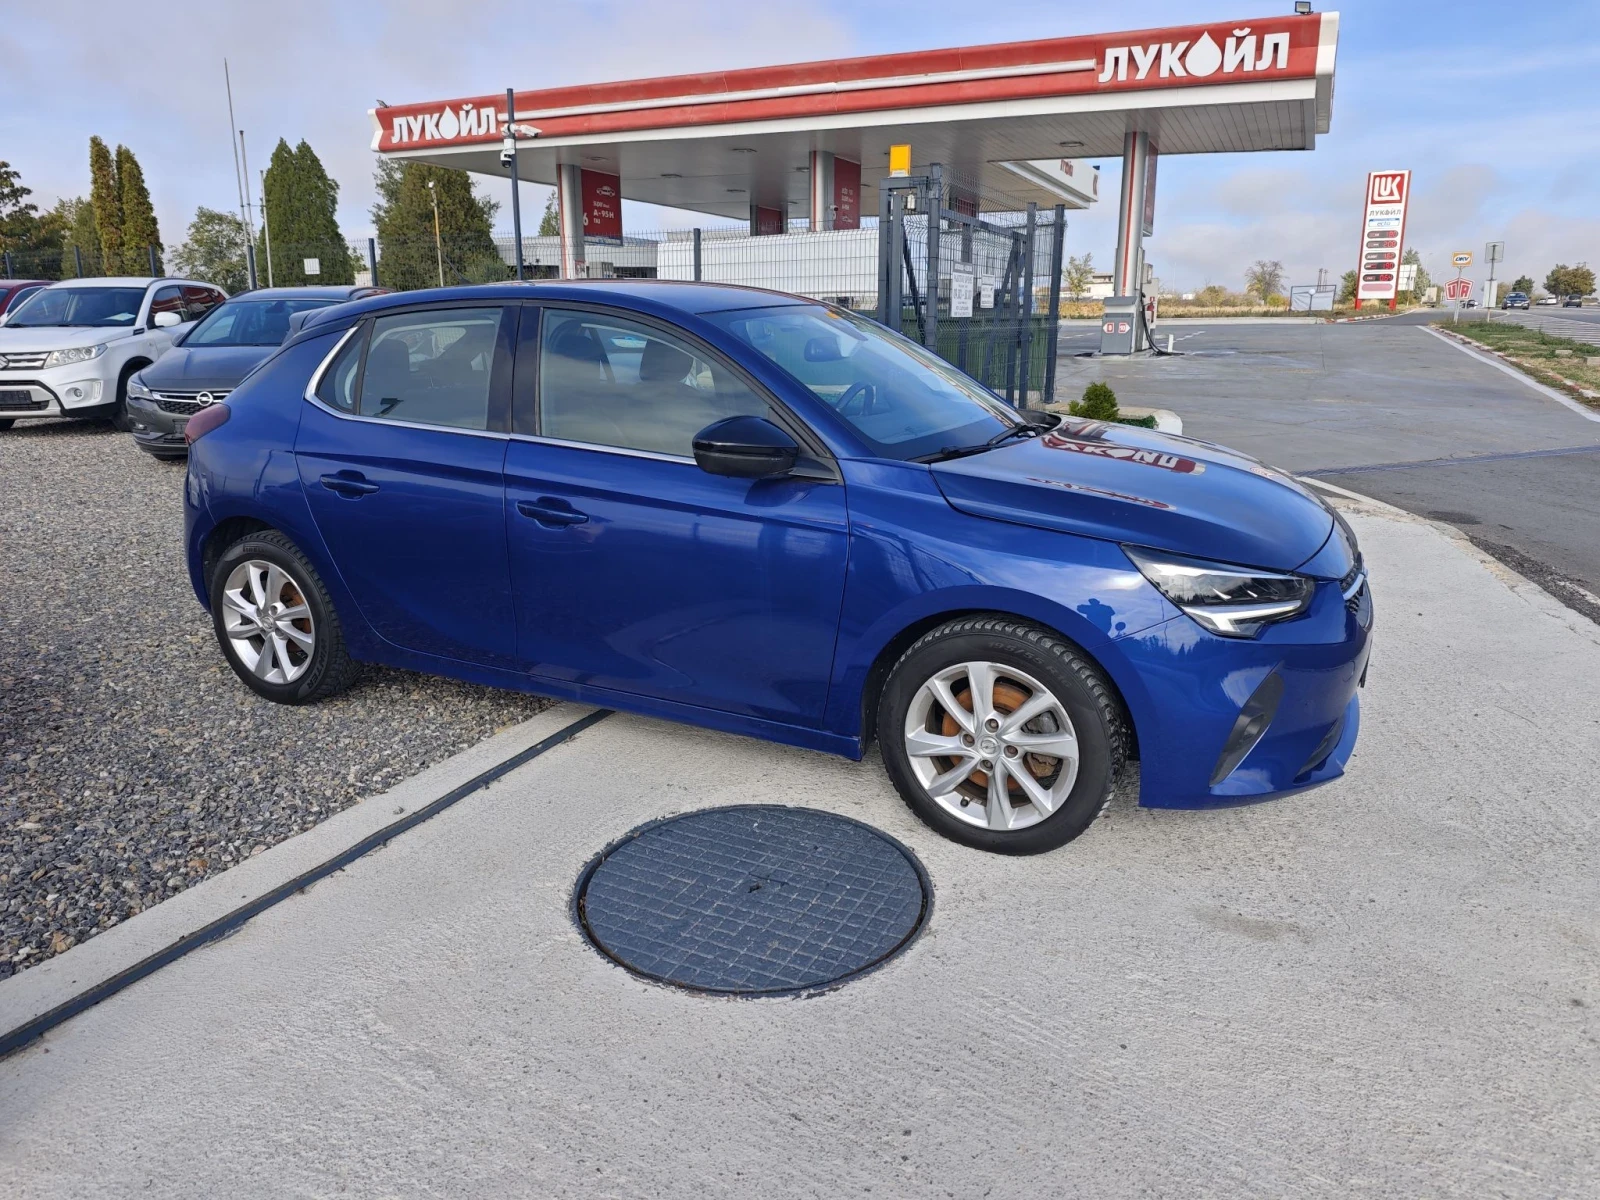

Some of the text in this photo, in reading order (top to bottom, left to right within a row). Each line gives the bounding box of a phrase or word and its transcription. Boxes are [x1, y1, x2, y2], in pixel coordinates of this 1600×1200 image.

[1098, 27, 1291, 83] ЛУКОЙЛ
[391, 103, 497, 144] ЛУКОЙЛ
[988, 641, 1045, 665] 195/55
